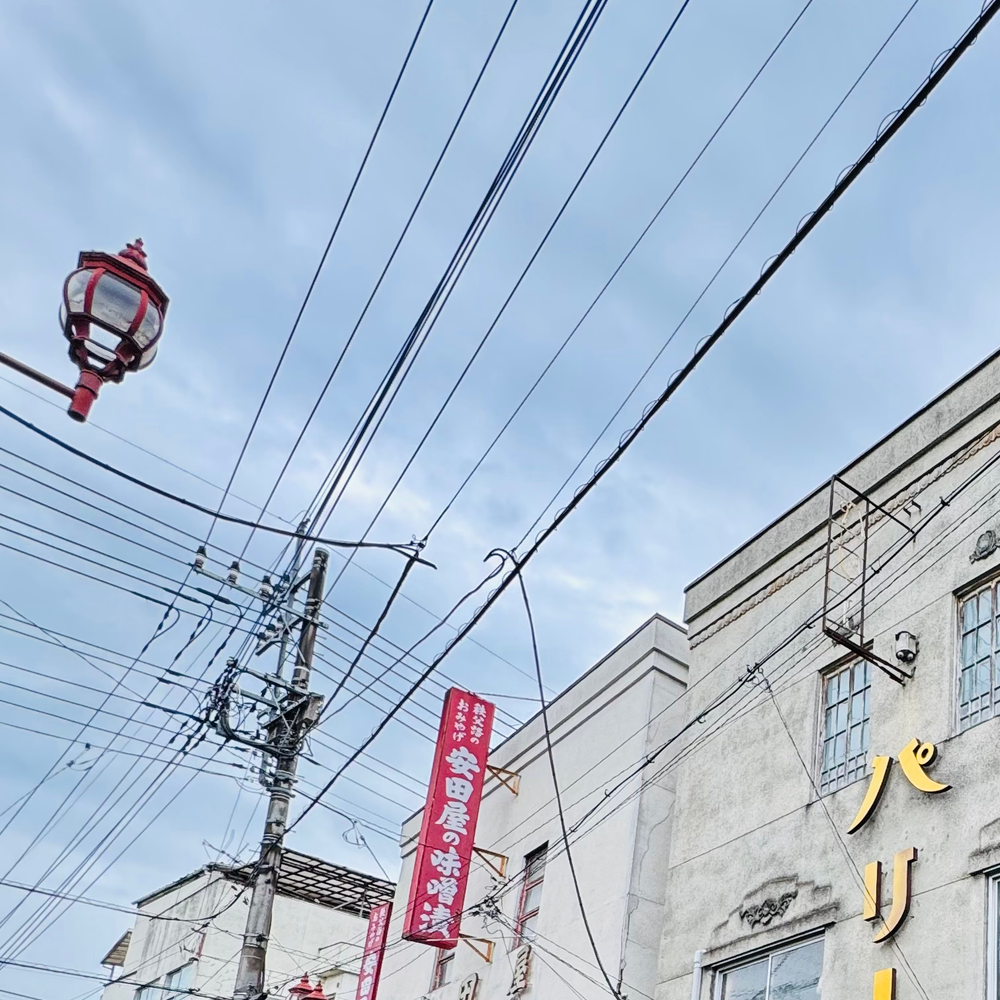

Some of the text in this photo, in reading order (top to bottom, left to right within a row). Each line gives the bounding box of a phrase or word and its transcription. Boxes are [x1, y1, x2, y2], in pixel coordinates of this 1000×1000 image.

[452, 698, 470, 742] おみやげ
[418, 746, 481, 940] 安田屋の味噌漬
